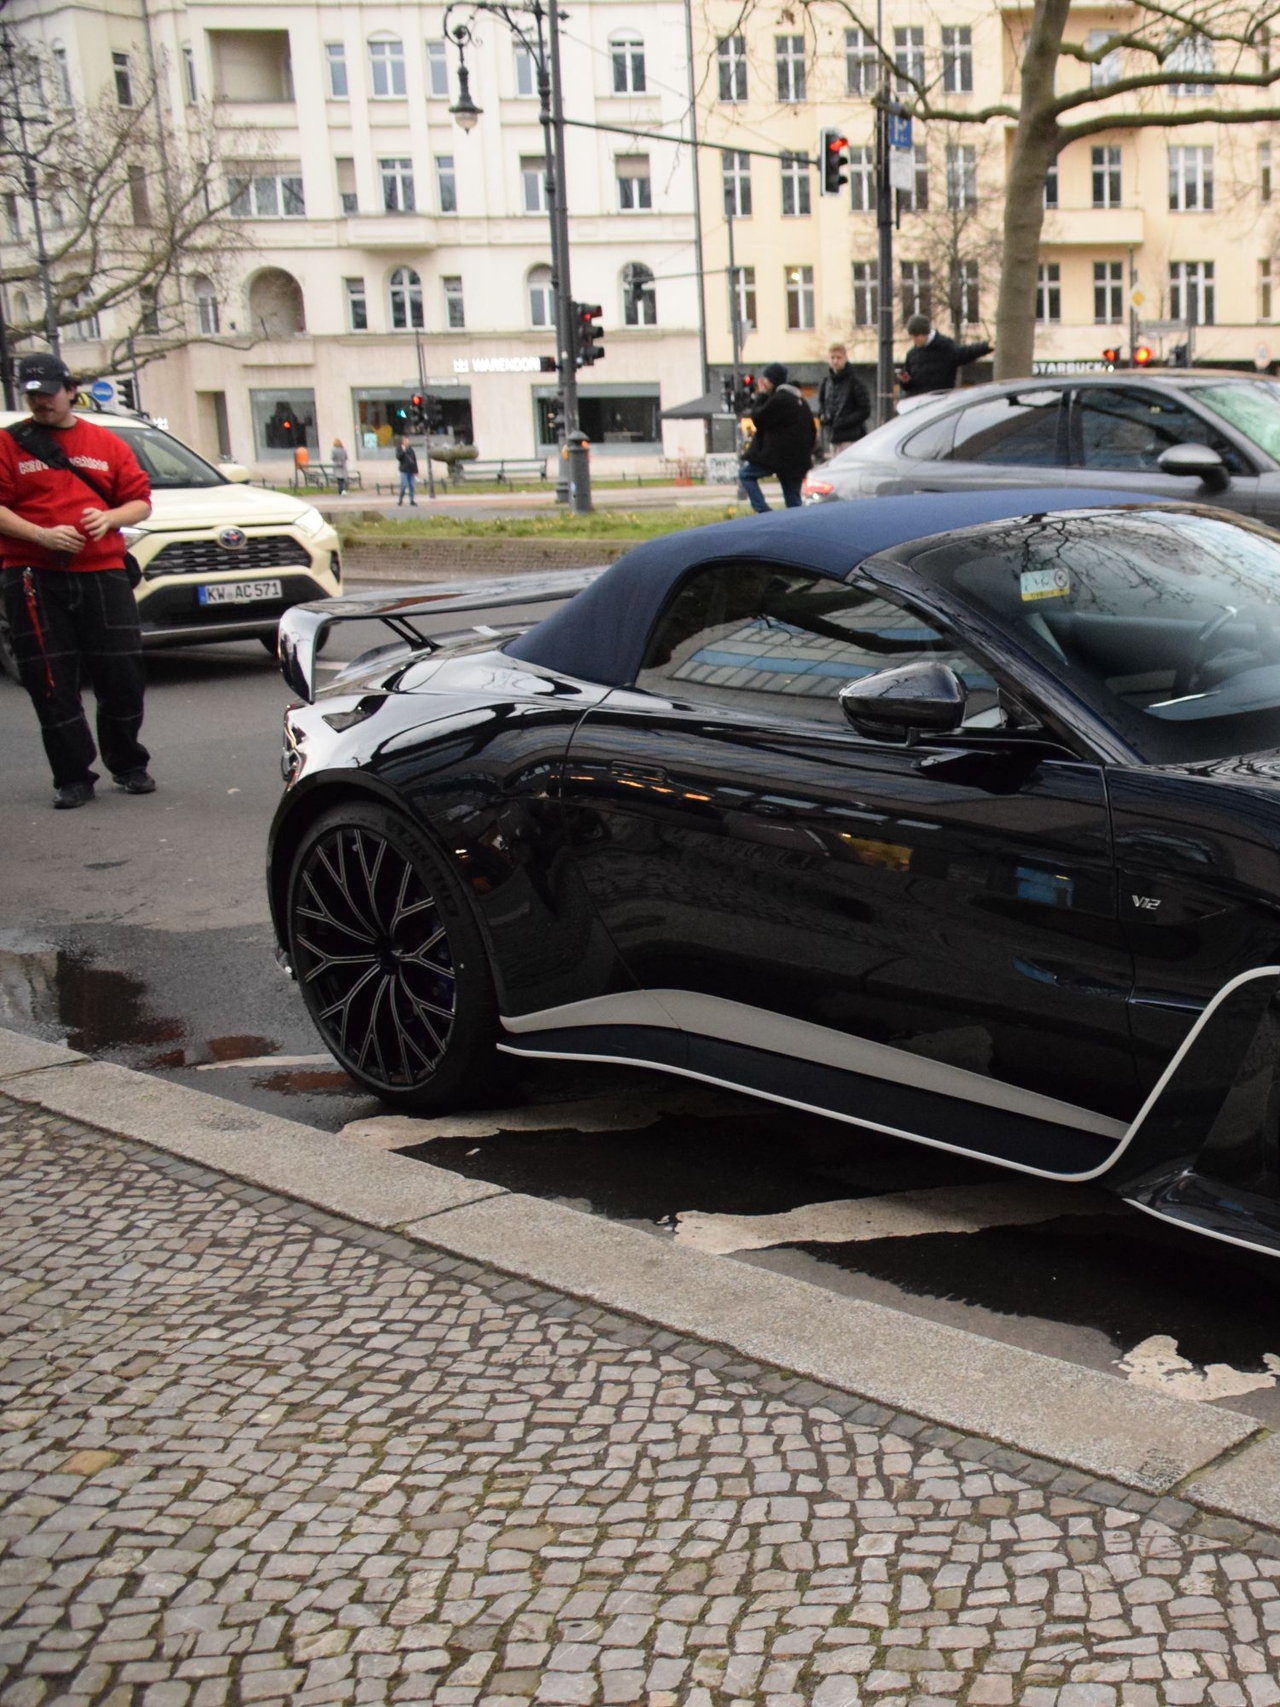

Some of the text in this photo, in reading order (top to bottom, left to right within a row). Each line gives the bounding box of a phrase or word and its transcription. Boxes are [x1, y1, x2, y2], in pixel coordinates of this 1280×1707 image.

[1032, 361, 1104, 376] STARBUCK
[207, 582, 280, 601] KW AC 571
[1131, 894, 1161, 910] V12
